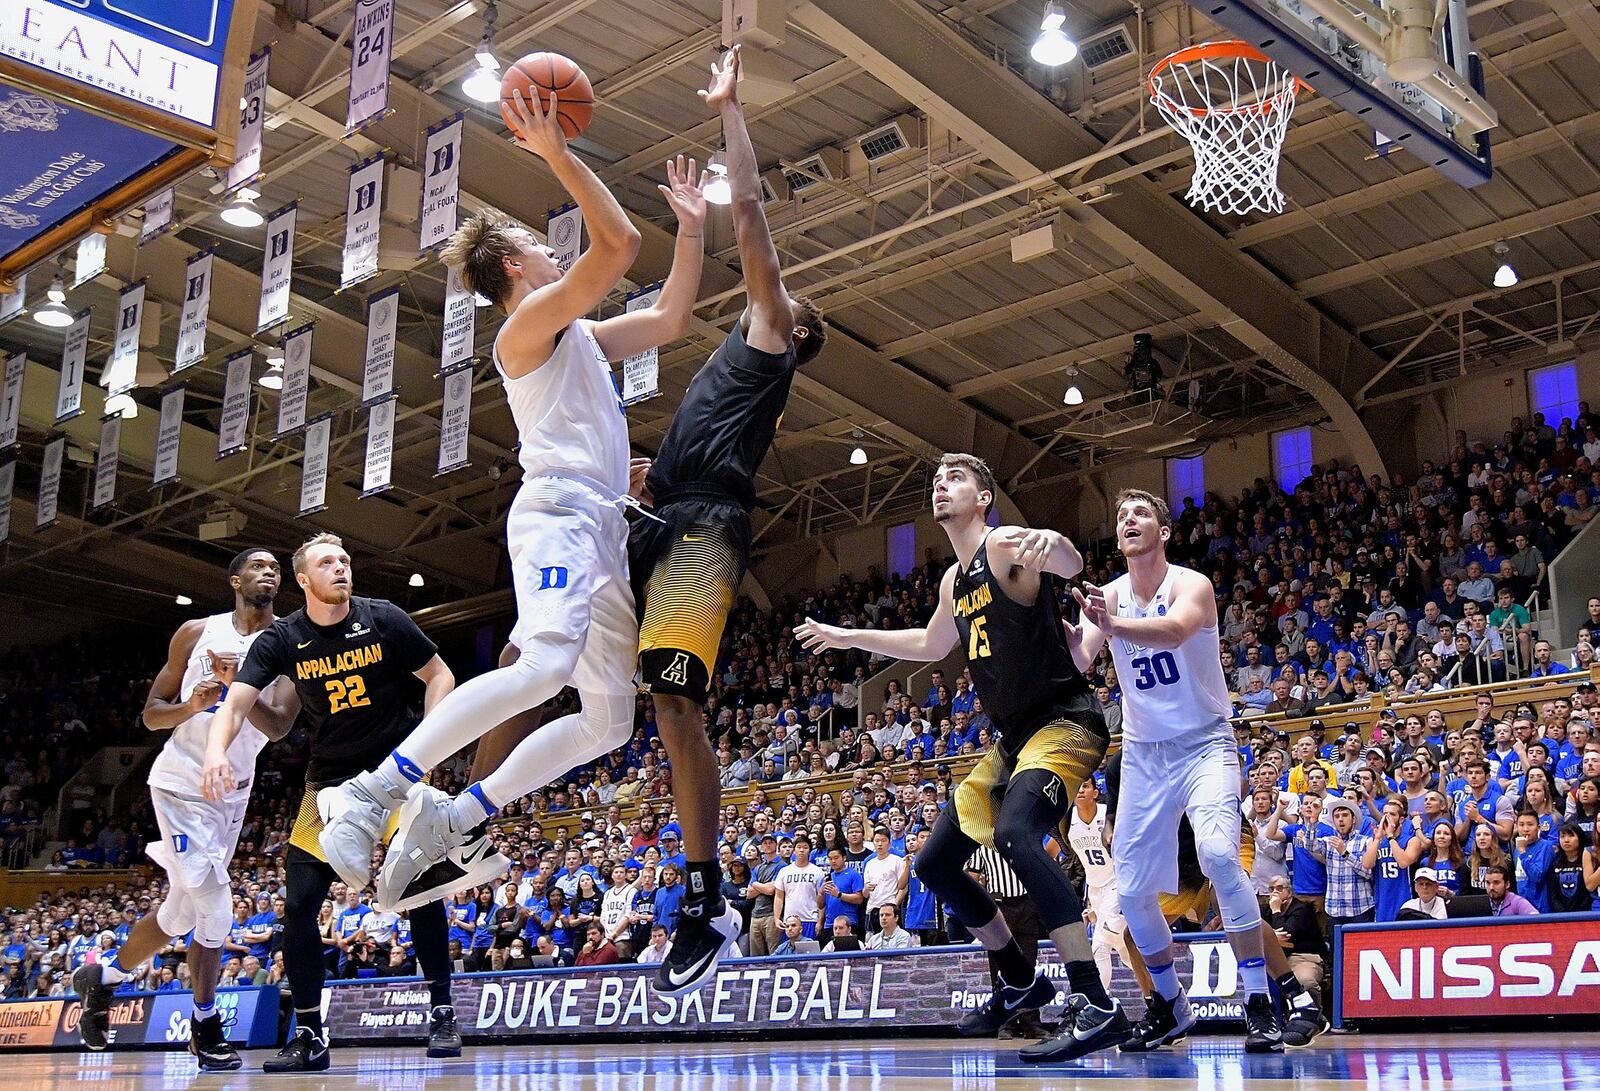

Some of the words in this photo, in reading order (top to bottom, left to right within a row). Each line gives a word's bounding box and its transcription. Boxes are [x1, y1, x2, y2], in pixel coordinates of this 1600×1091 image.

[357, 2, 389, 35] DAWKINS
[358, 27, 385, 67] 24
[1, 170, 61, 204] Washington
[49, 152, 85, 171] Duke
[27, 196, 55, 208] Inn
[53, 174, 84, 191] Golf
[73, 160, 105, 177] Club
[438, 195, 455, 209] FOUR
[355, 221, 369, 234] NCAA
[443, 312, 473, 332] CONFERENCE
[452, 307, 468, 320] COAST
[444, 323, 471, 341] CHAMPIONS
[367, 350, 394, 367] CONFERENCE
[67, 360, 75, 387] 1
[968, 615, 992, 660] 15
[296, 643, 383, 681] APPALACHIAN
[1131, 650, 1181, 691] 30
[324, 675, 372, 715] 22
[1084, 849, 1106, 865] 15
[787, 873, 814, 884] DUKE
[1381, 862, 1399, 878] 15
[1437, 869, 1456, 880] KE
[608, 913, 618, 924] 12
[1358, 940, 1600, 1001] NISSA
[383, 991, 391, 1005] 7
[391, 990, 431, 1005] National
[476, 978, 587, 1029] DUKE
[595, 963, 896, 1026] BASKETBALL
[1191, 1002, 1243, 1018] GoDuke
[360, 1012, 394, 1029] Players
[395, 1011, 407, 1023] of
[406, 1011, 423, 1025] the
